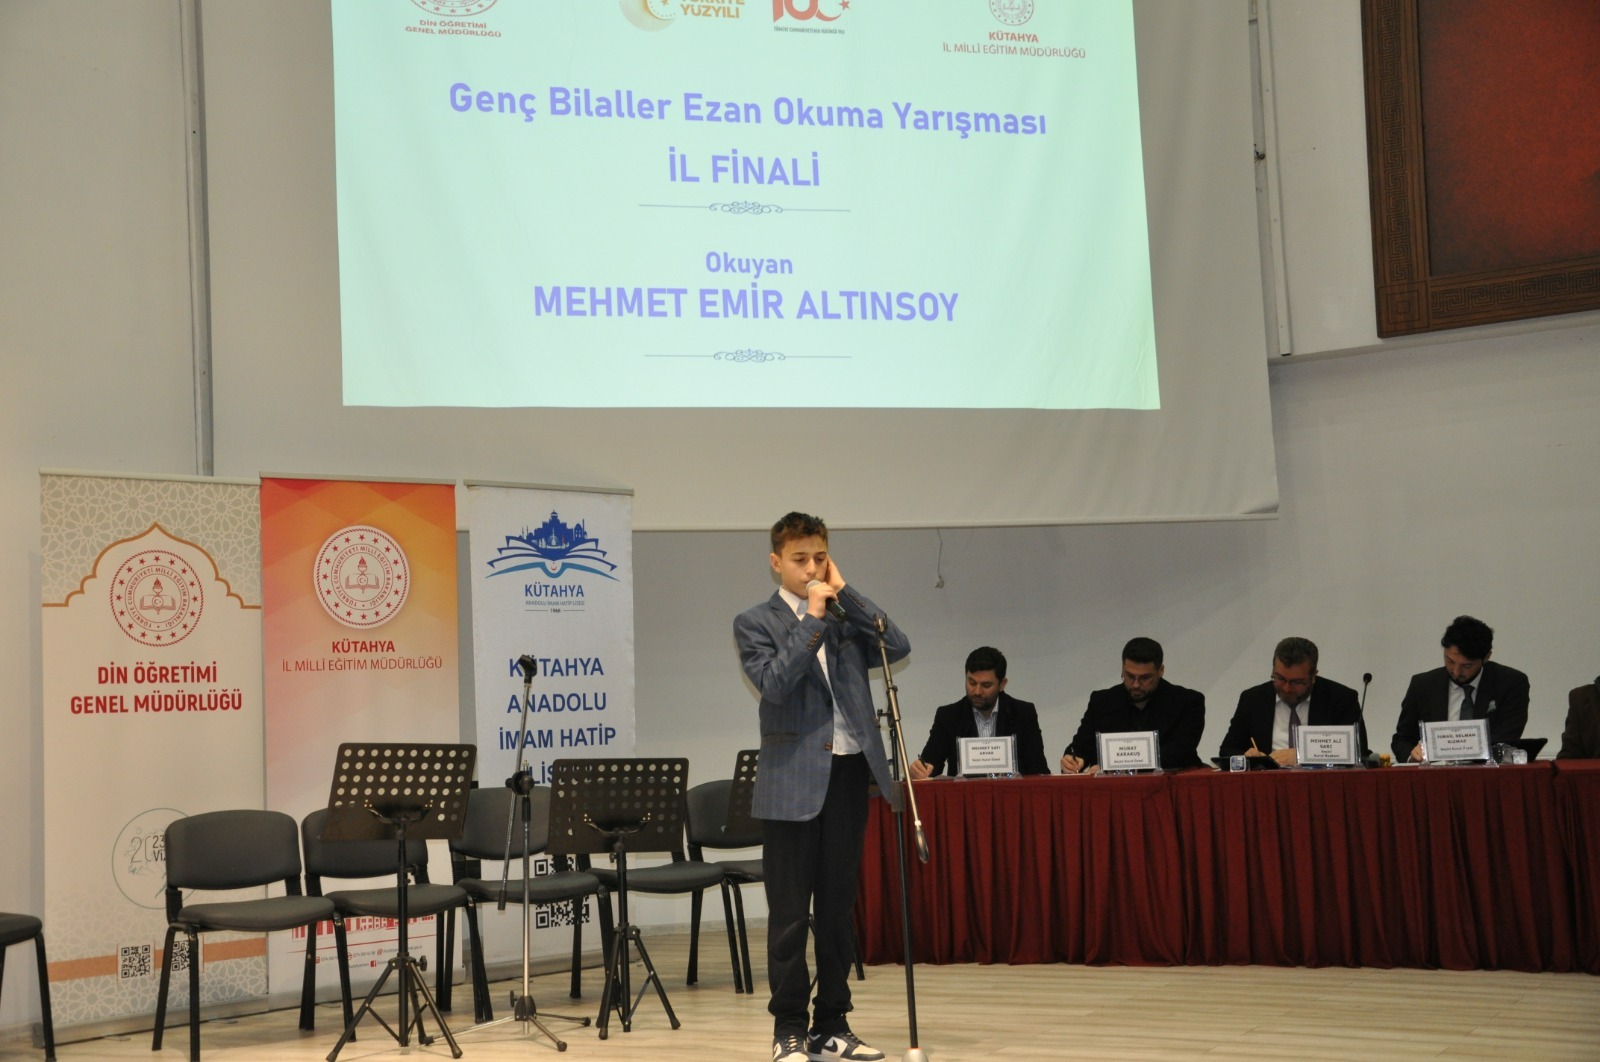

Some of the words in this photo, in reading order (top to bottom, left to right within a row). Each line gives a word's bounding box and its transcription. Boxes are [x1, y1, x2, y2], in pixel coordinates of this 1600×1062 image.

[680, 4, 740, 18] YÜZYILI
[405, 26, 436, 34] GENEL
[438, 28, 502, 38] MÜDÜRLÜĞÜ
[440, 20, 487, 29] ÖĞRETİMİ
[988, 30, 1039, 43] KÜTAHYA
[942, 42, 952, 52] İL
[983, 44, 1018, 55] EĞİTİM
[1020, 46, 1086, 58] MÜDÜRLÜĞÜ
[450, 82, 536, 122] Genç
[549, 86, 671, 120] Bilaller
[683, 92, 762, 124] Ezan
[773, 97, 884, 129] Okuma
[892, 101, 1047, 140] Yarışması
[668, 146, 700, 182] İL
[711, 148, 820, 187] FİNALİ
[705, 251, 793, 279] Okuyan
[534, 285, 688, 318] MEHMET
[699, 281, 784, 319] EMİR
[796, 290, 959, 322] ALTINSOY
[524, 582, 584, 598] KÜTAHYA
[332, 638, 396, 653] KÜTAHYA
[98, 662, 128, 684] DİN
[134, 661, 218, 684] ÖĞRETİMİ
[282, 659, 292, 672] İL
[328, 657, 368, 671] EĞİTİM
[370, 656, 442, 670] MÜDÜRLÜĞÜ
[509, 654, 604, 677] KTAHYA
[70, 695, 128, 714] GENEL
[134, 689, 242, 712] MÜDÜRLÜĞÜ
[506, 692, 606, 714] ANADOLU
[499, 727, 554, 750] İMAM
[560, 724, 616, 748] HATİP
